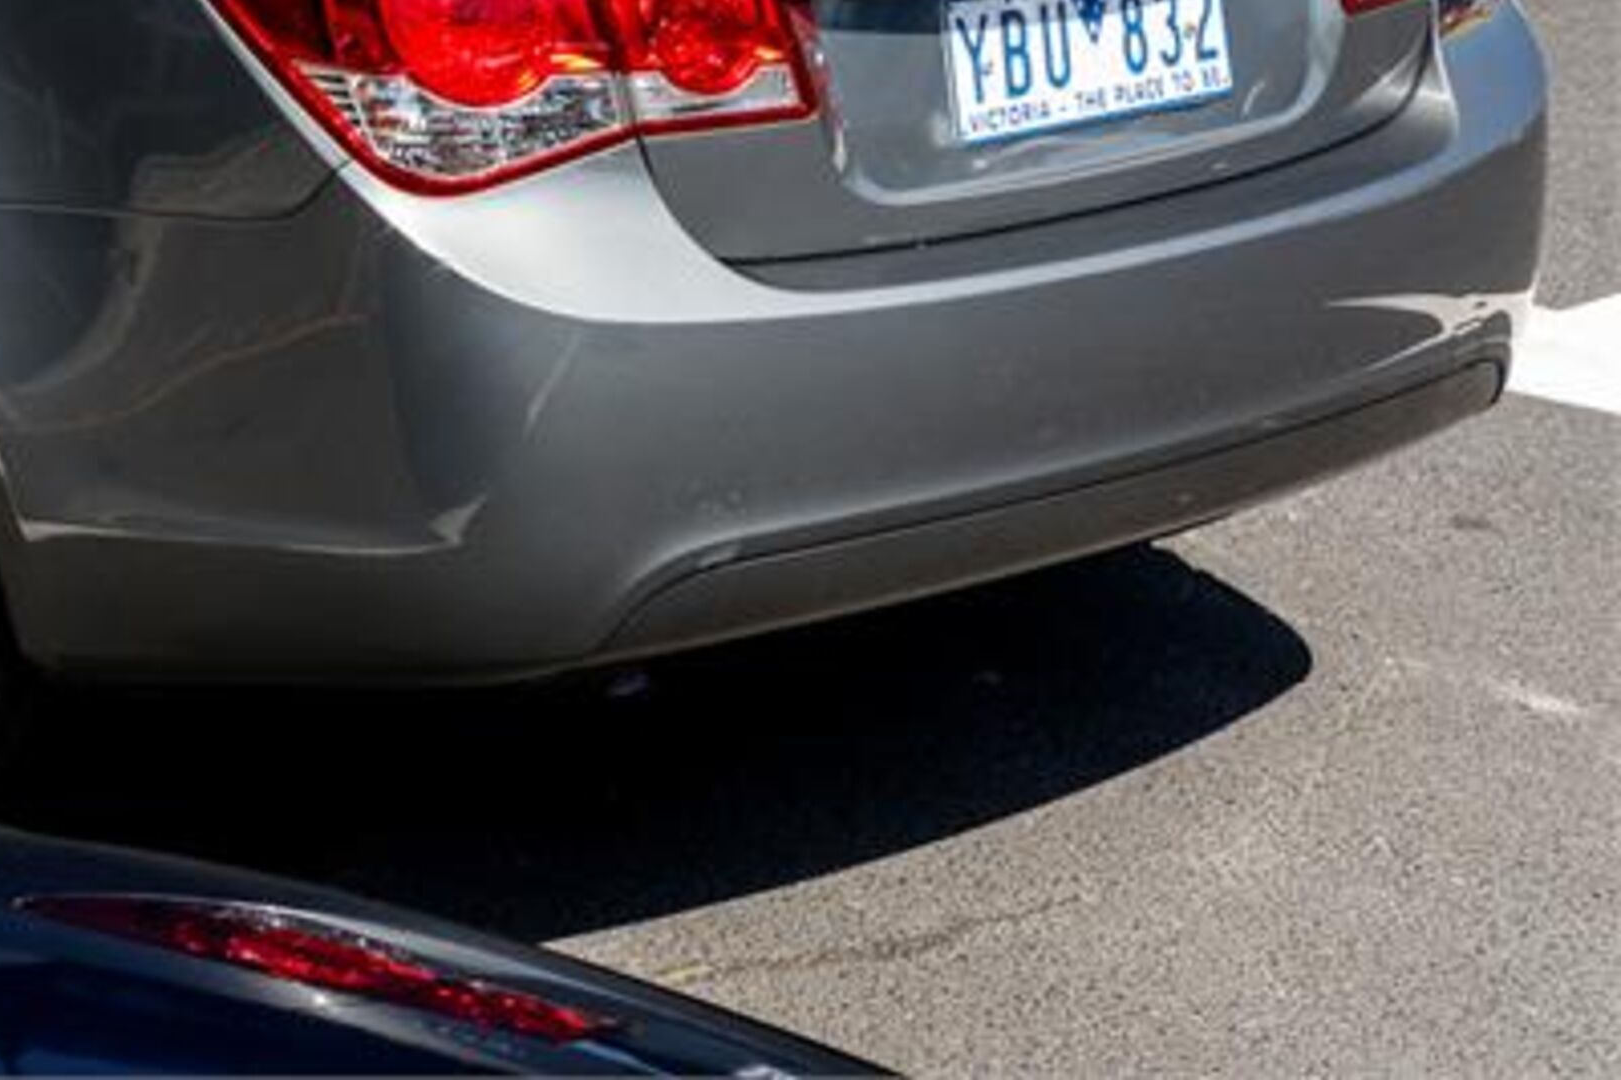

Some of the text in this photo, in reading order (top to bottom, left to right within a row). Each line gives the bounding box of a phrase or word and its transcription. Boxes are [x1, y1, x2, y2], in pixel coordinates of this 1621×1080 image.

[956, 1, 1072, 104] YBU
[968, 101, 1051, 132] VICTORIA
[1075, 87, 1107, 111] THE
[1114, 75, 1165, 103] PLACE
